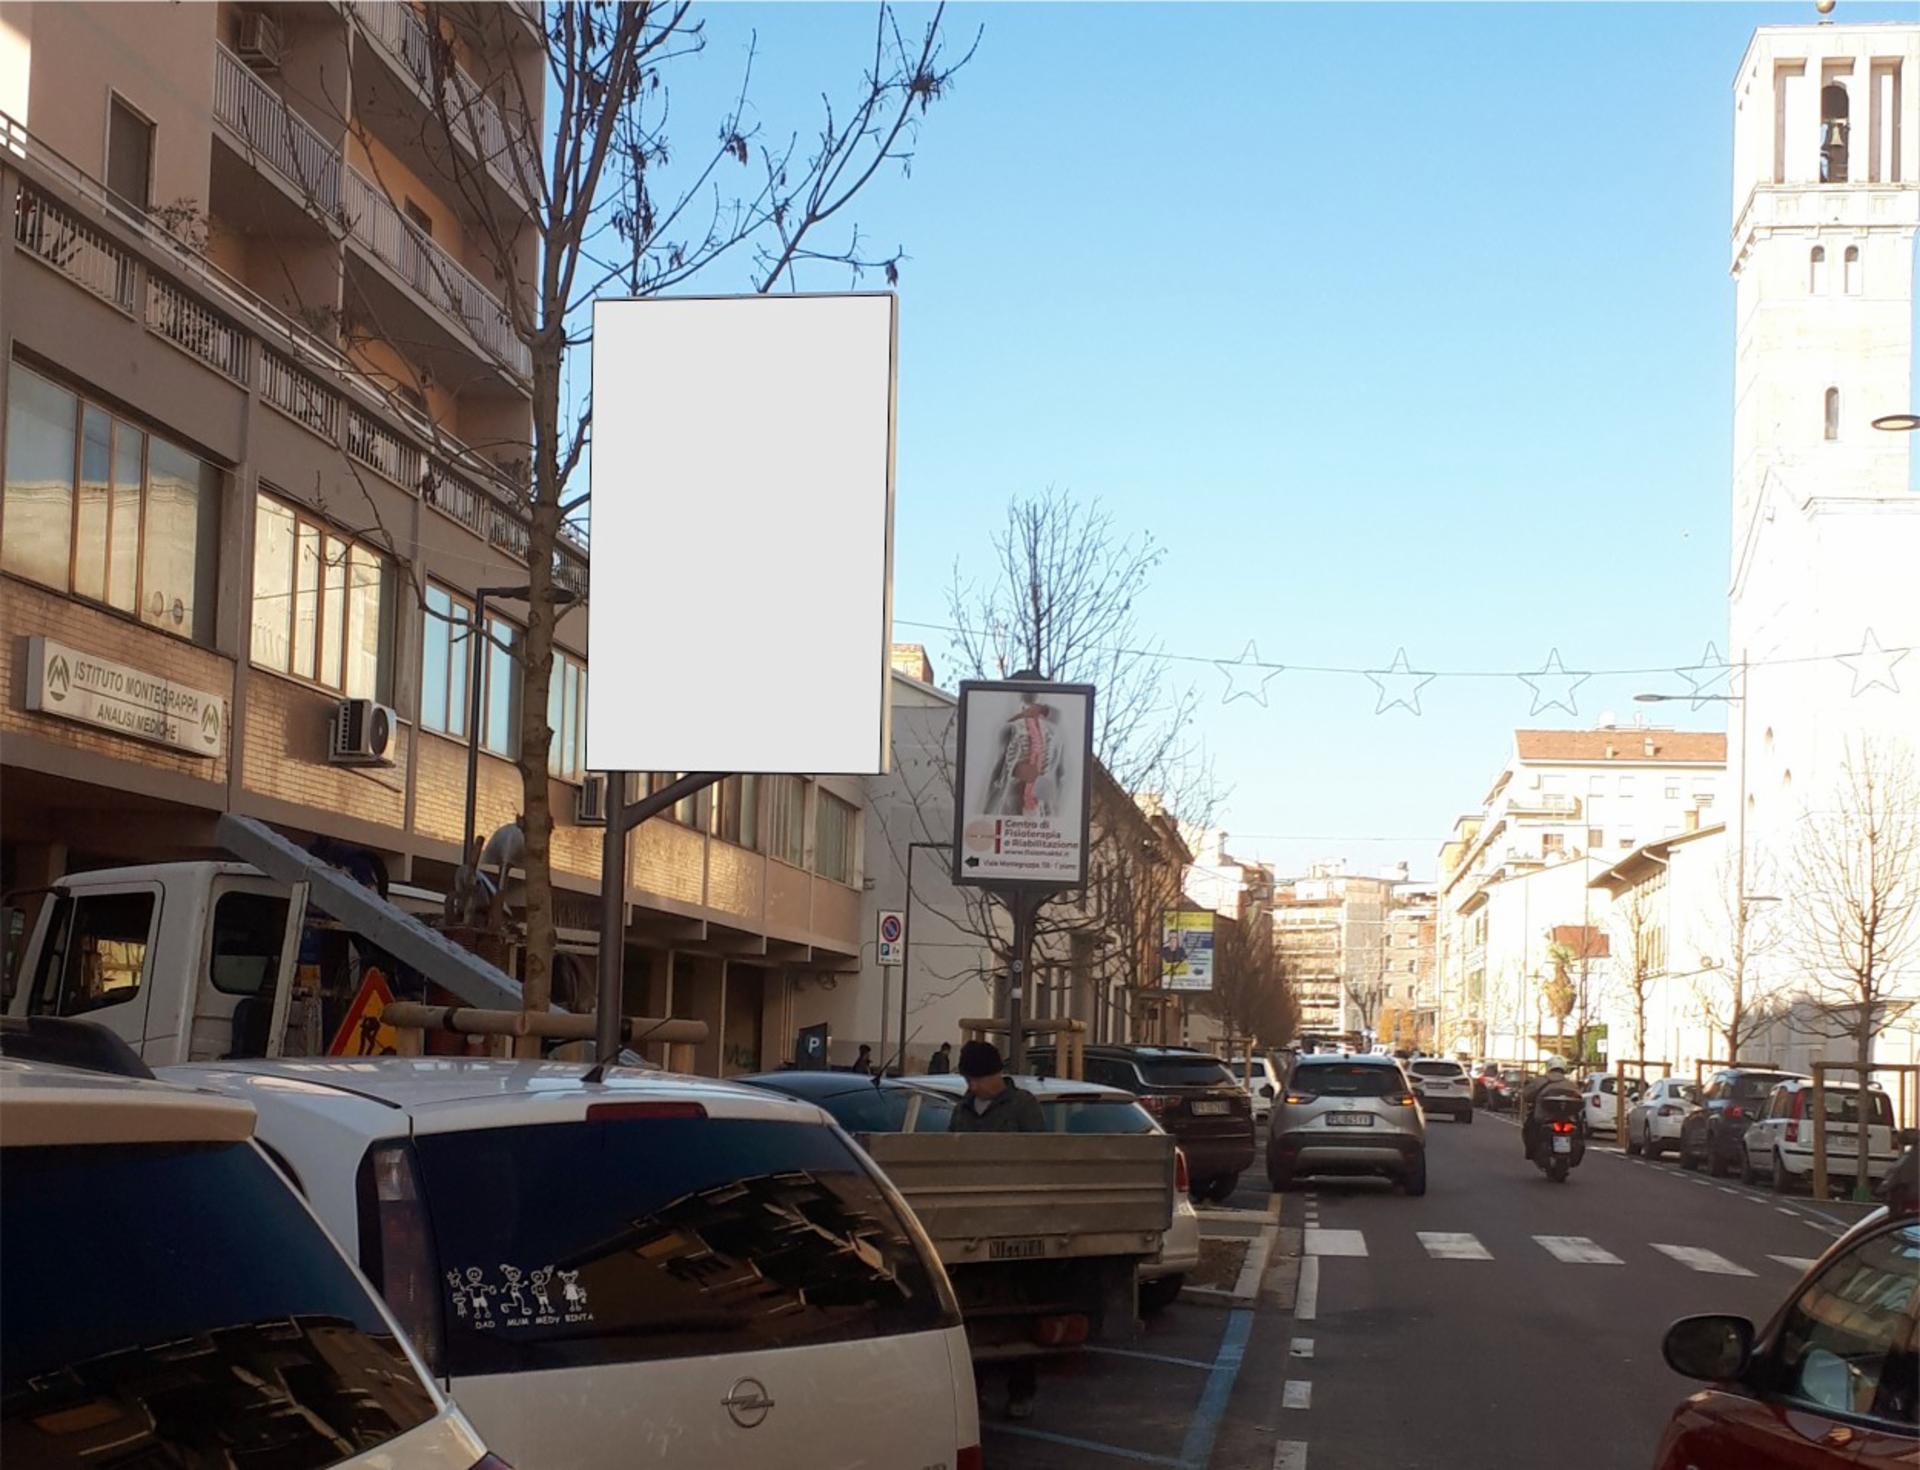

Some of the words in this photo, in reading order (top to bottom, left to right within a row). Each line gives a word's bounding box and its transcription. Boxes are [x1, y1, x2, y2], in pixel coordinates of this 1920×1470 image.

[74, 661, 123, 692] ISTITUTO
[126, 677, 198, 716] MONTEGRAPPA
[97, 704, 134, 728] ANALISI
[137, 716, 176, 740] MEDICHE
[1005, 820, 1037, 829] Centro
[1040, 821, 1050, 829] di
[1004, 829, 1061, 840] Fisioterapia
[1012, 840, 1079, 849] Riabilitazione
[808, 1037, 820, 1054] P
[475, 1320, 496, 1330] DAD
[506, 1317, 530, 1327] MUM
